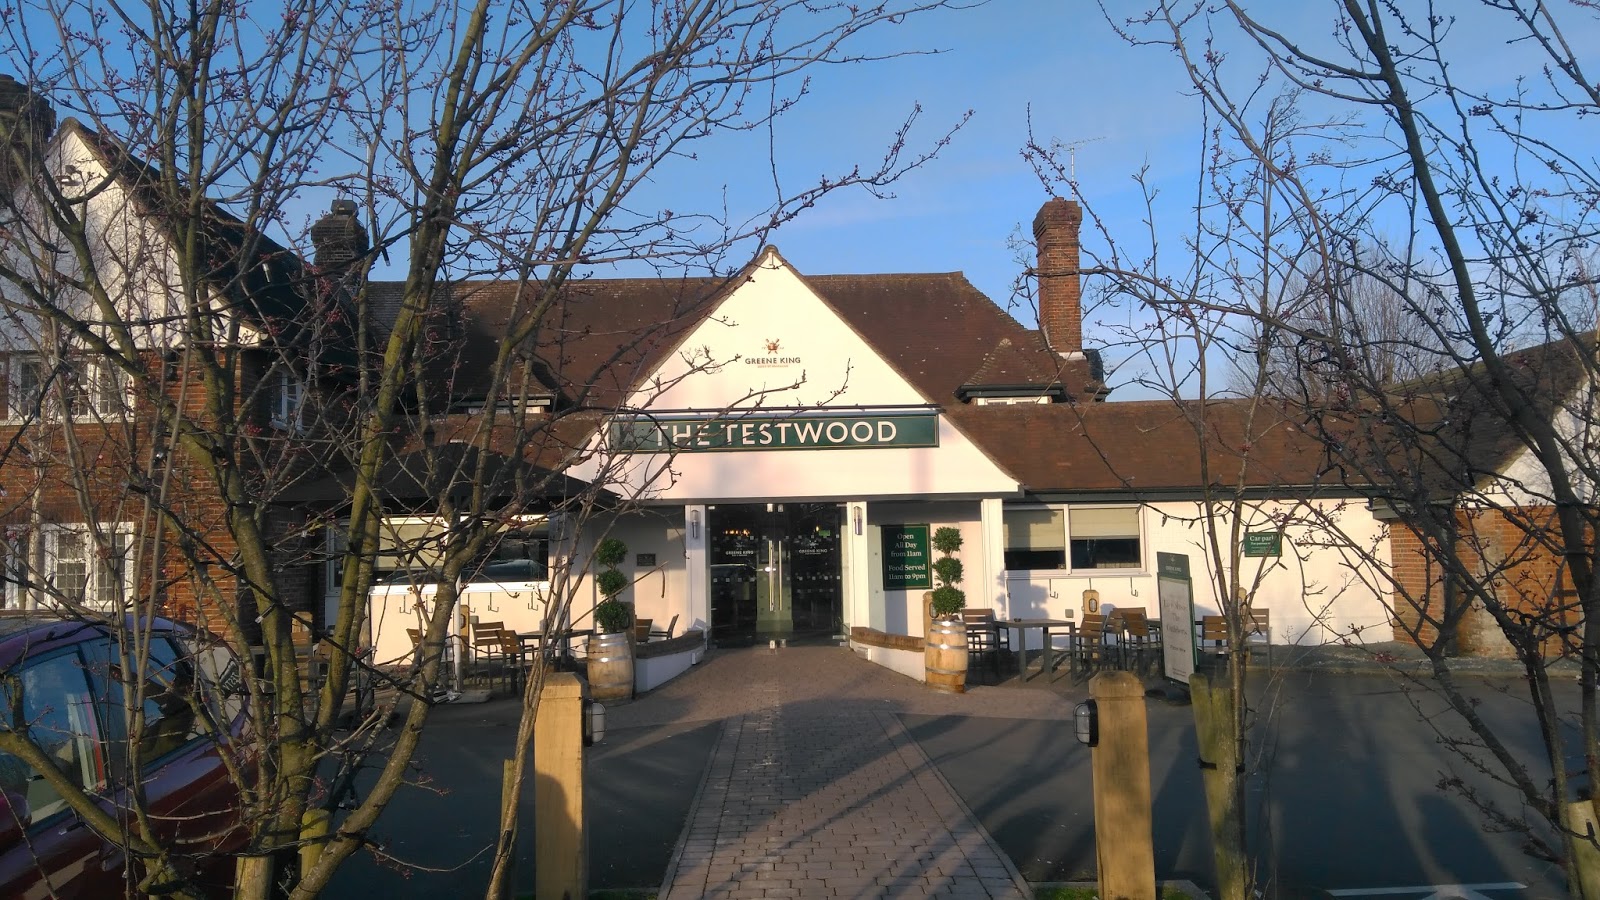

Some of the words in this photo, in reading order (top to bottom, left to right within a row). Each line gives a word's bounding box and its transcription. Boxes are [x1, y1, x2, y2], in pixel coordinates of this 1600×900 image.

[744, 357, 778, 365] GREENE
[779, 356, 801, 364] KING
[654, 424, 710, 447] THE
[720, 421, 897, 445] TESTWOOD
[912, 573, 926, 581] 9pm
